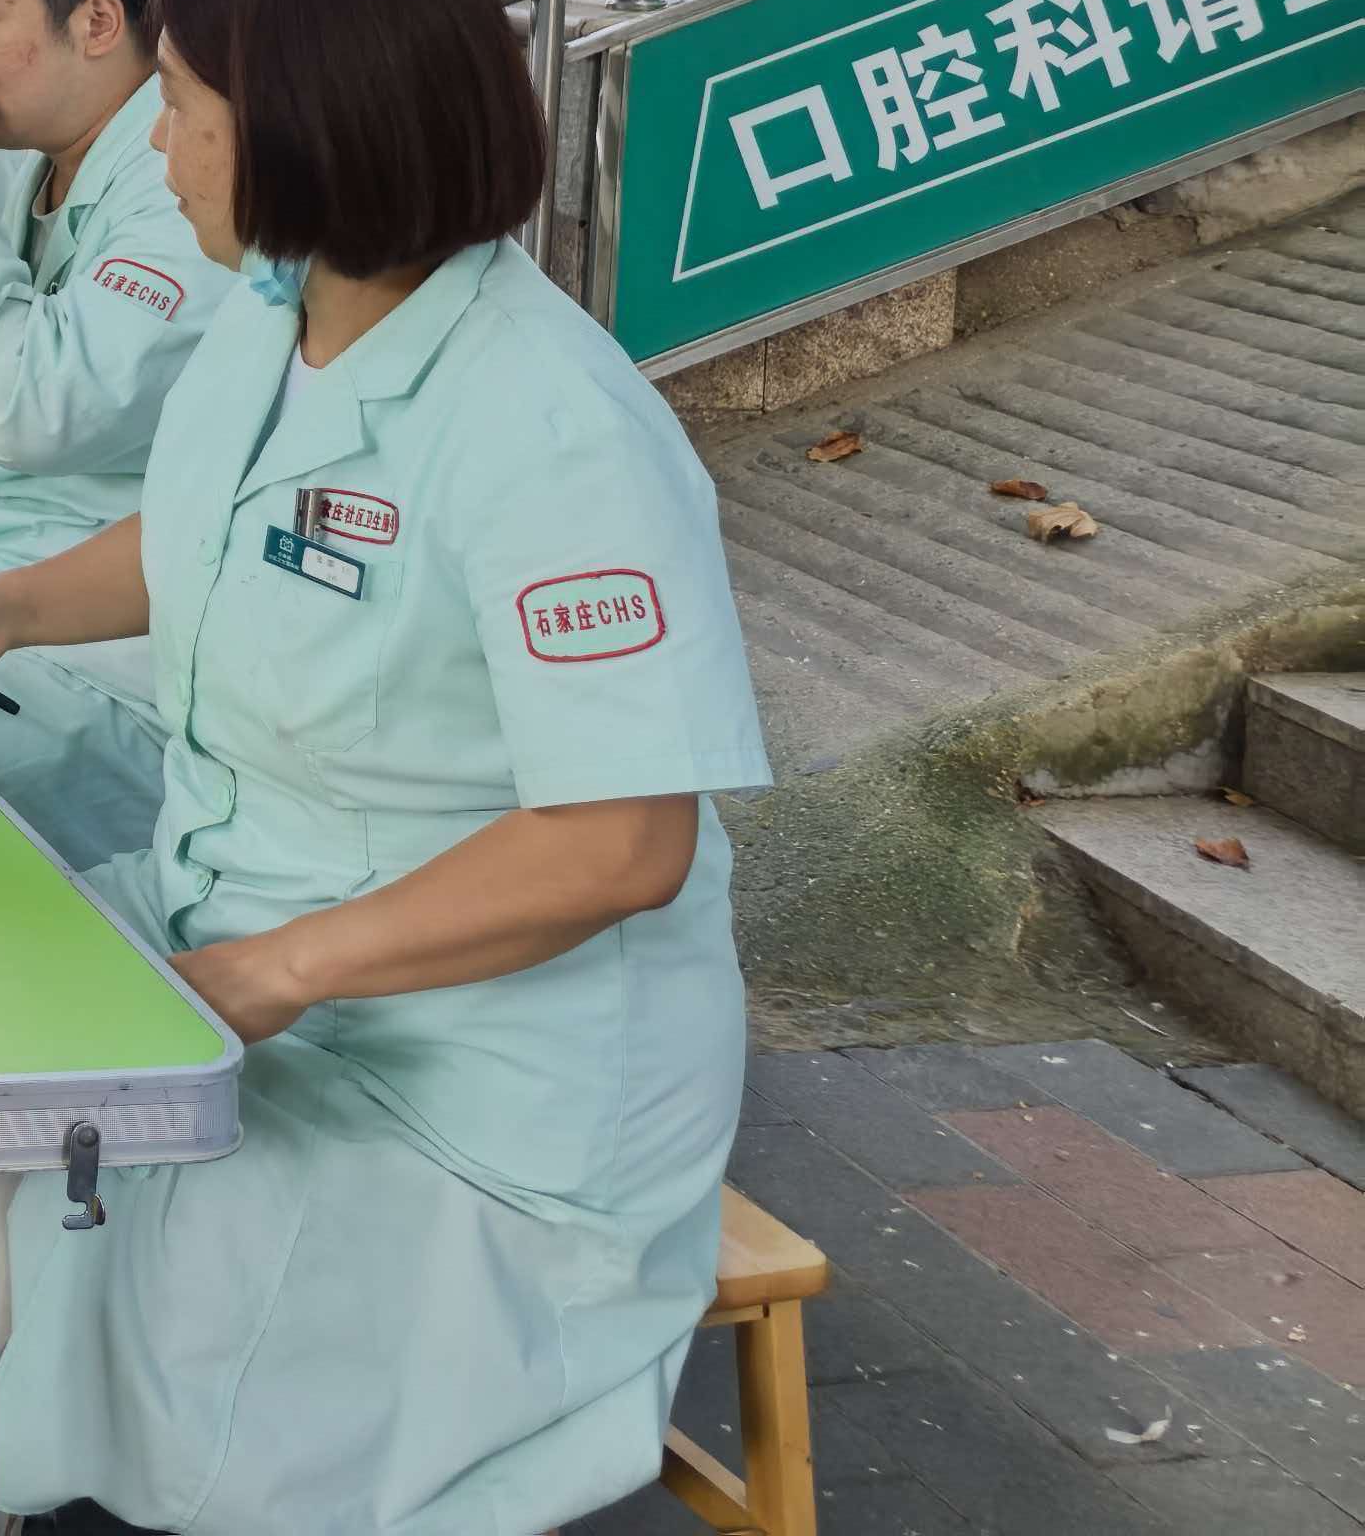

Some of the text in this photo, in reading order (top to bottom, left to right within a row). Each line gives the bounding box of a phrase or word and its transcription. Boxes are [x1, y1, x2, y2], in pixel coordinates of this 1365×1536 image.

[101, 271, 170, 311] 石家庄CHS
[532, 593, 647, 638] 石家庄CHS
